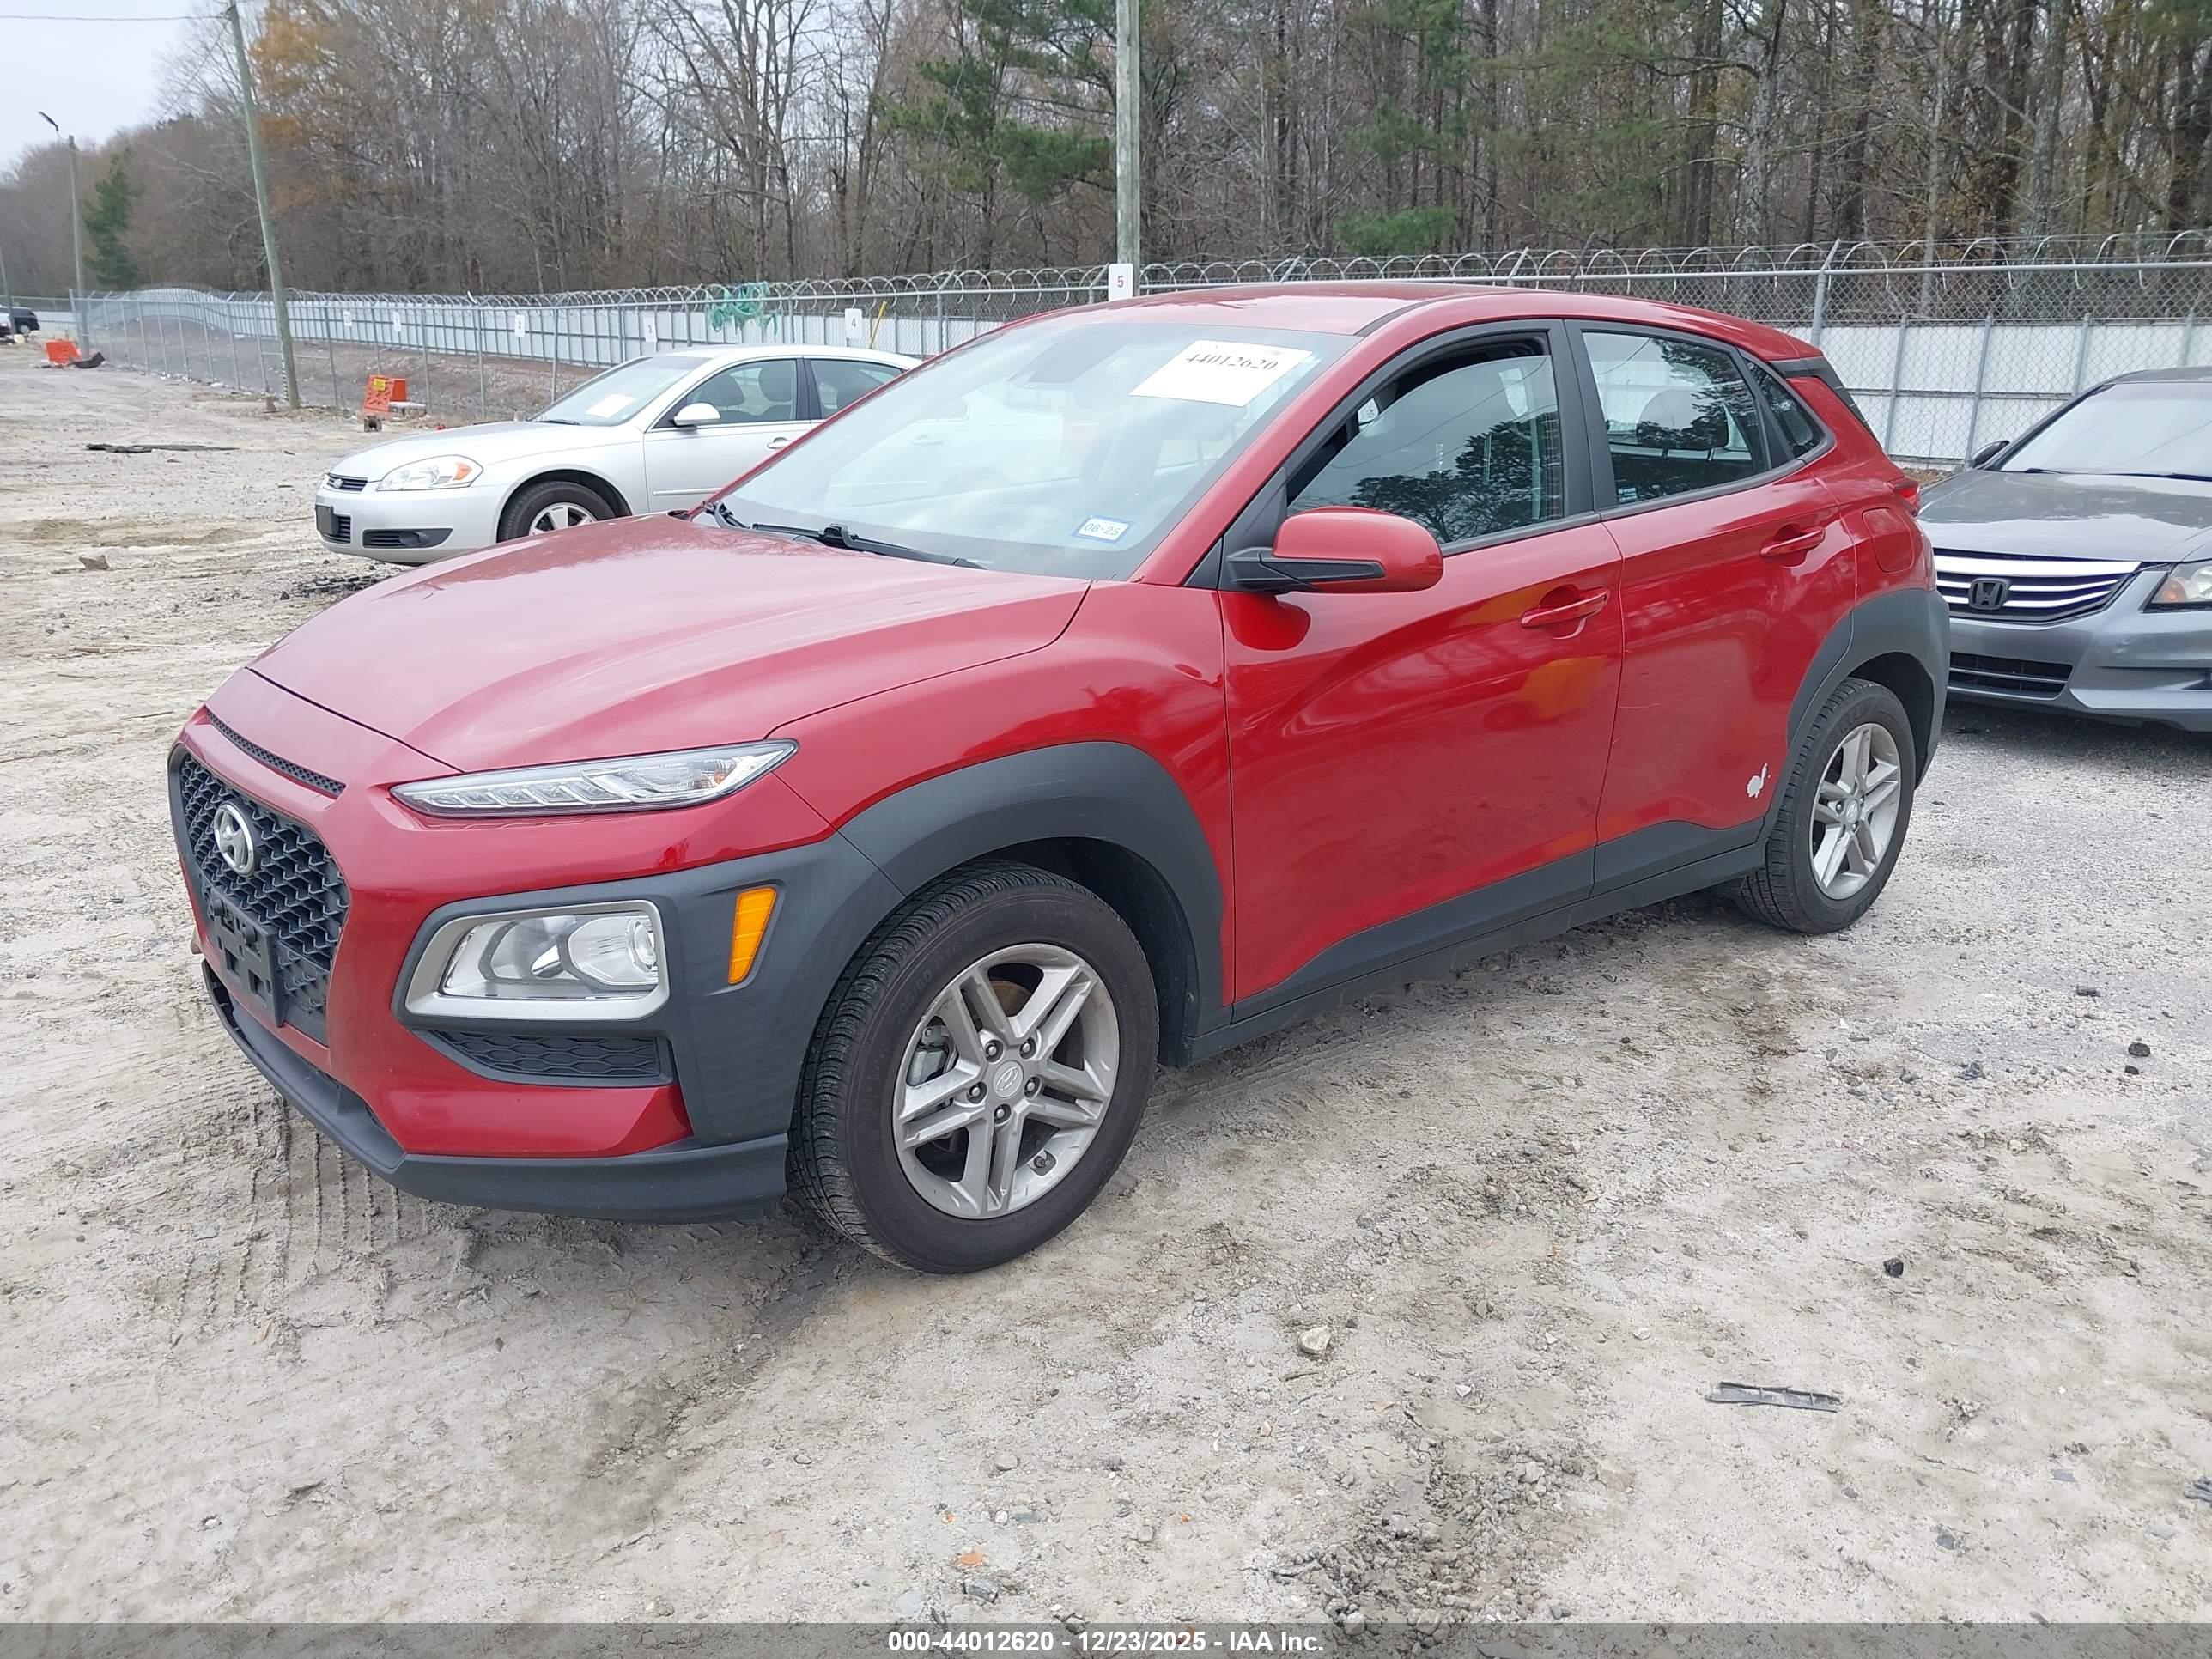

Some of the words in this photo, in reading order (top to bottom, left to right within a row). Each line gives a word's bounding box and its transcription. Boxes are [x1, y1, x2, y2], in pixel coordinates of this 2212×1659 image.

[1117, 275, 1124, 289] 5
[851, 318, 857, 327] 4
[1185, 353, 1279, 371] 44012620
